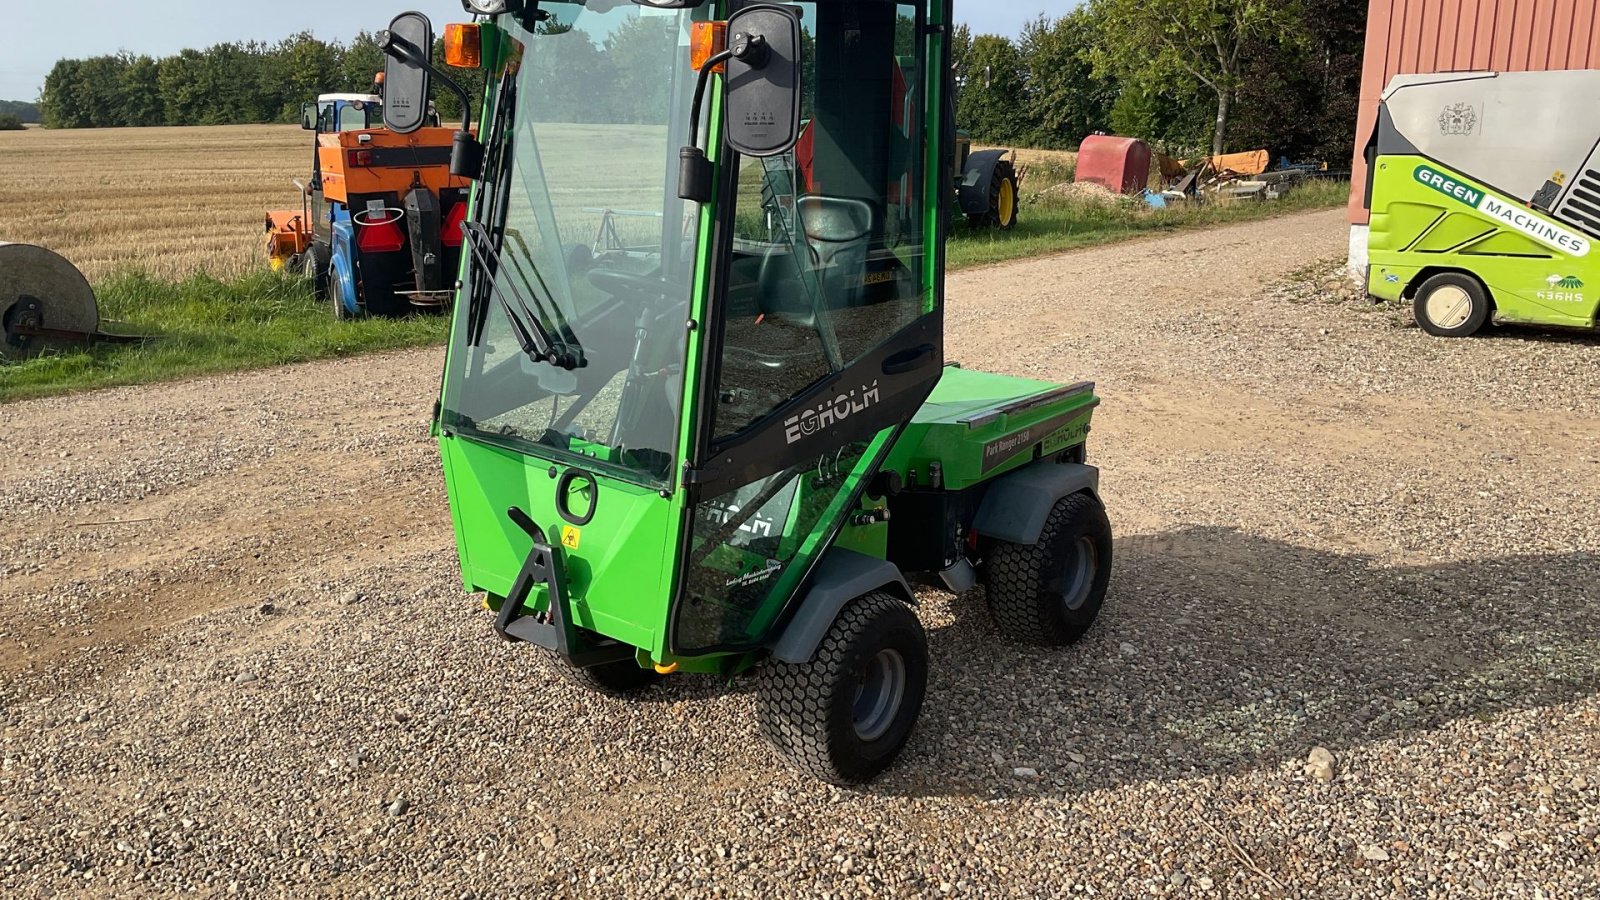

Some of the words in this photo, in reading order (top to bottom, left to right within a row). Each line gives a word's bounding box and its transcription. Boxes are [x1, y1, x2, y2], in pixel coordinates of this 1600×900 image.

[1418, 168, 1479, 204] GREEN
[1485, 200, 1583, 252] MACHINES
[784, 379, 880, 444] EGHOLM
[986, 442, 999, 456] Park
[999, 435, 1018, 451] Ranger
